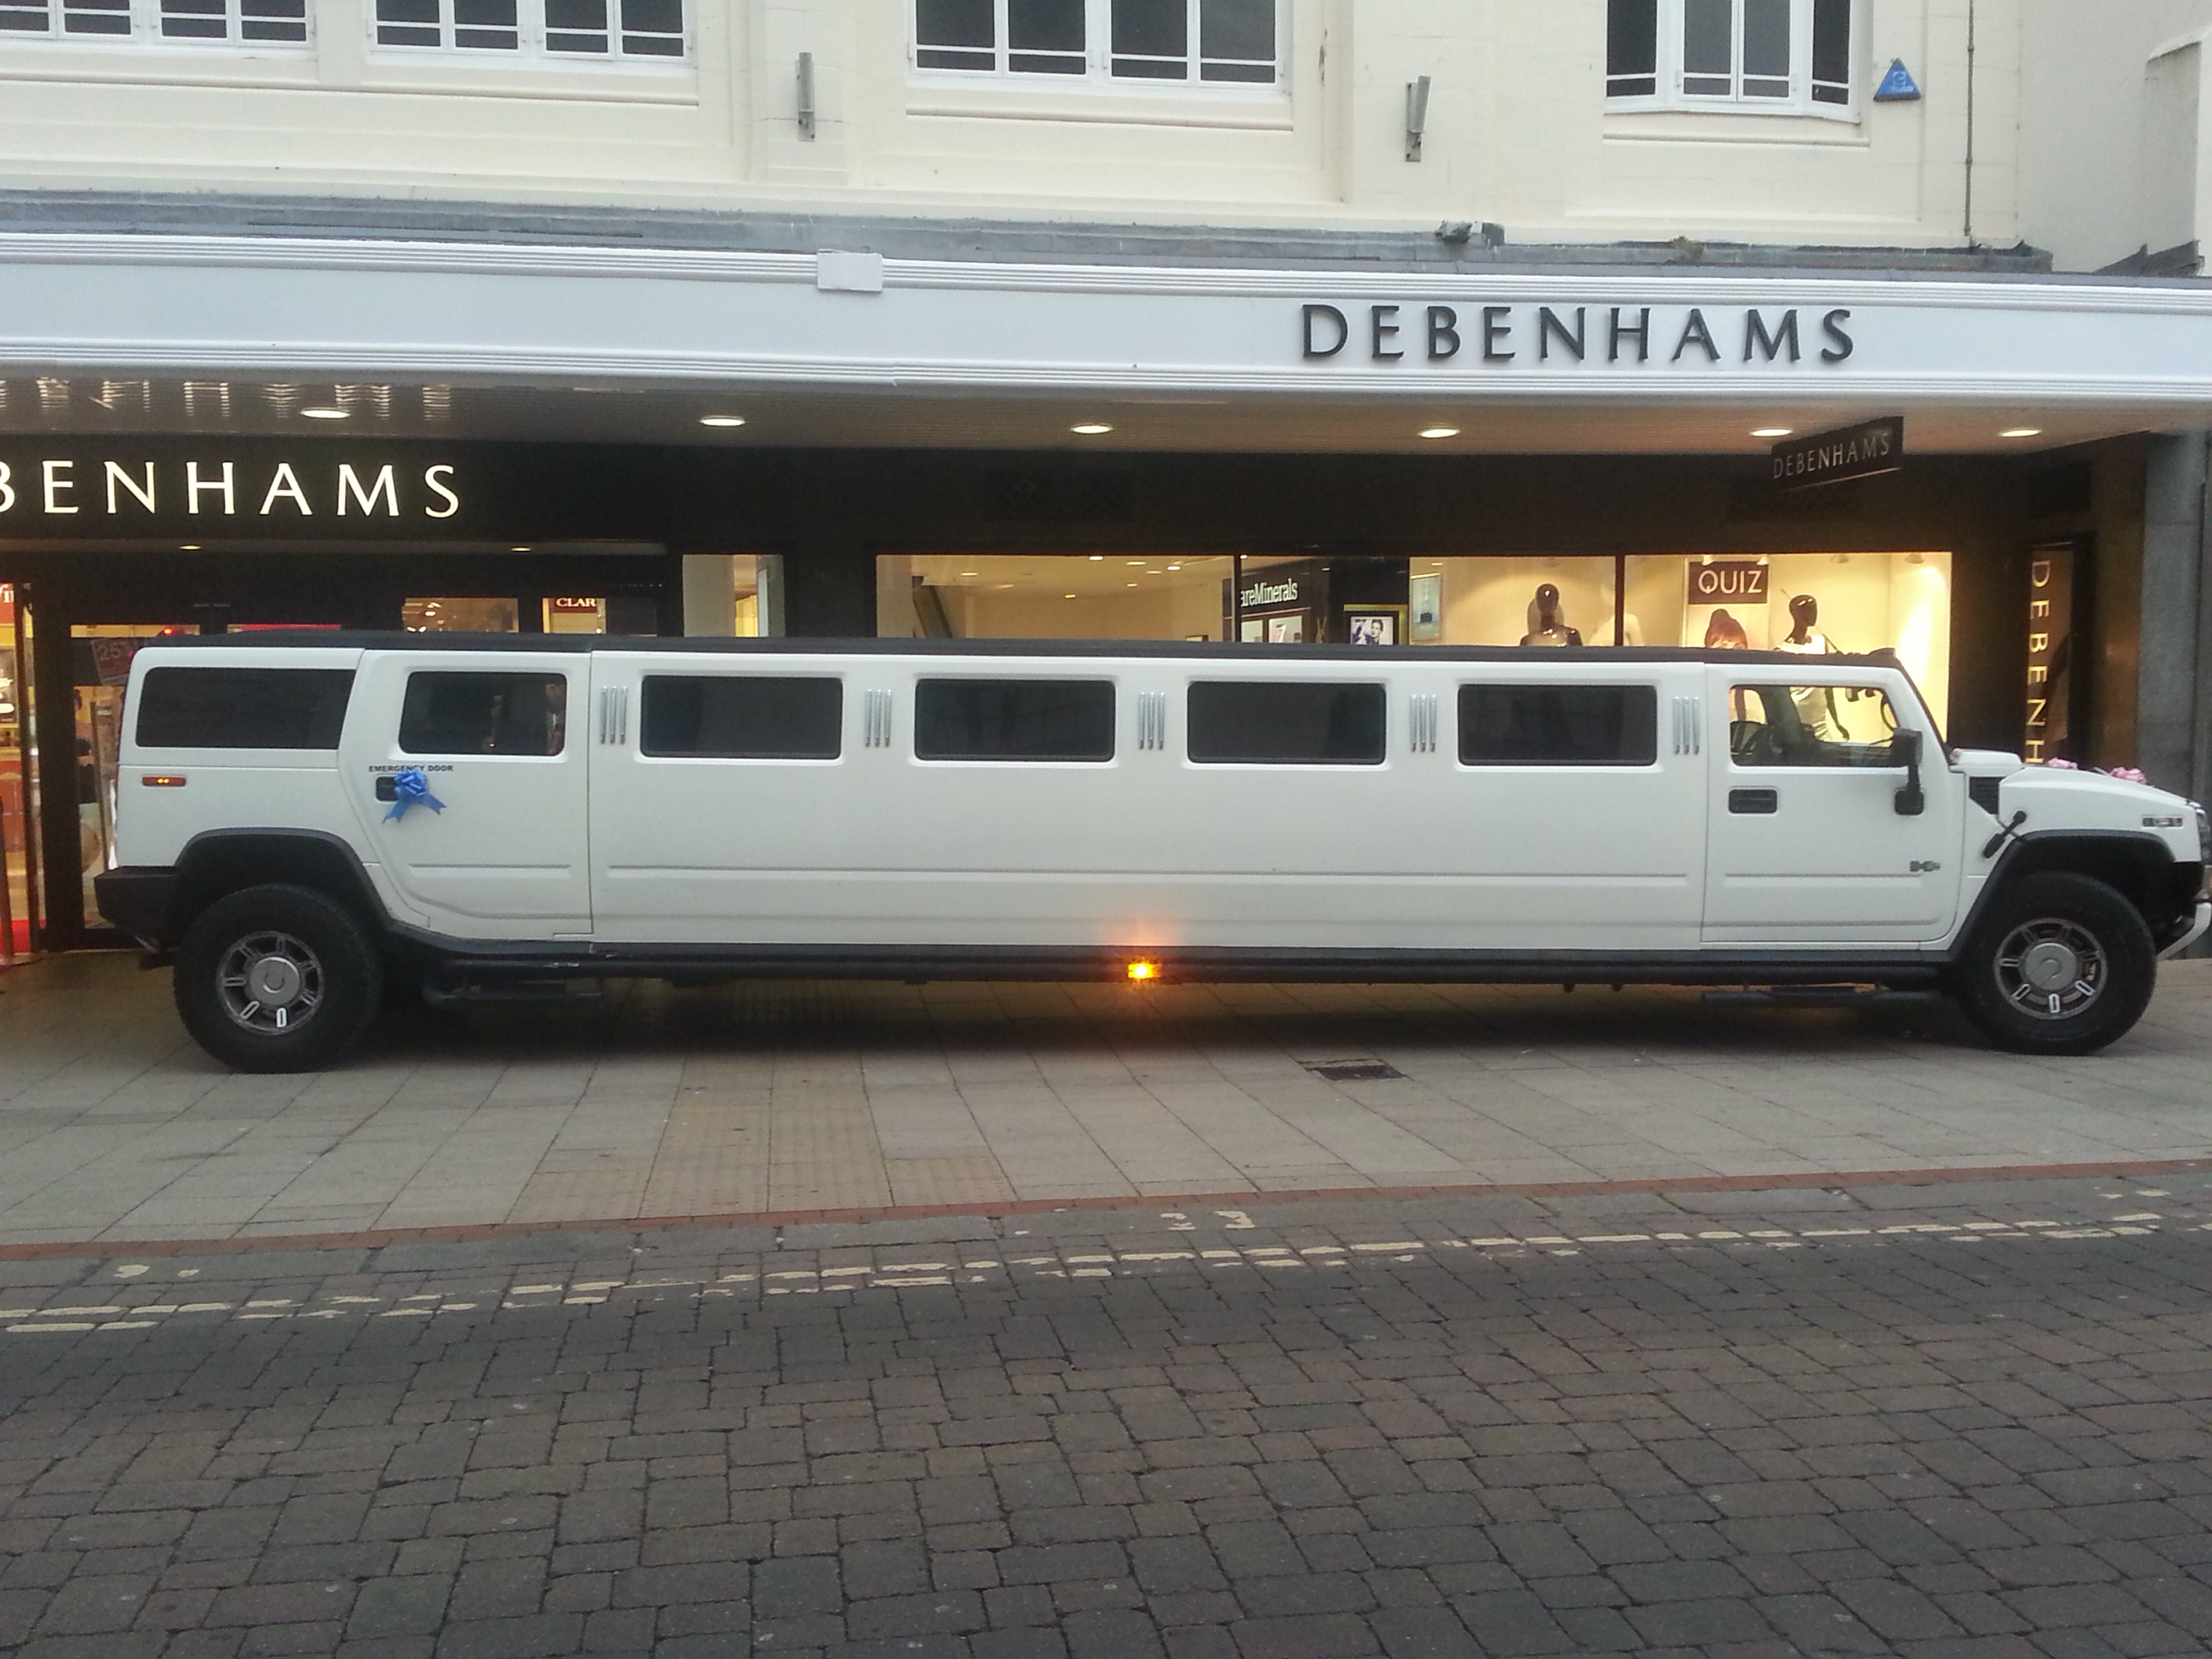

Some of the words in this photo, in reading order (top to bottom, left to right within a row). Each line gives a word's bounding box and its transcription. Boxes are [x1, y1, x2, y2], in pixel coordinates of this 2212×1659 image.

[1300, 304, 1855, 363] DEBENHAMS
[1773, 432, 1889, 479] DEBENHAMS
[1698, 570, 1763, 594] QUIZ
[556, 598, 596, 607] CLAR
